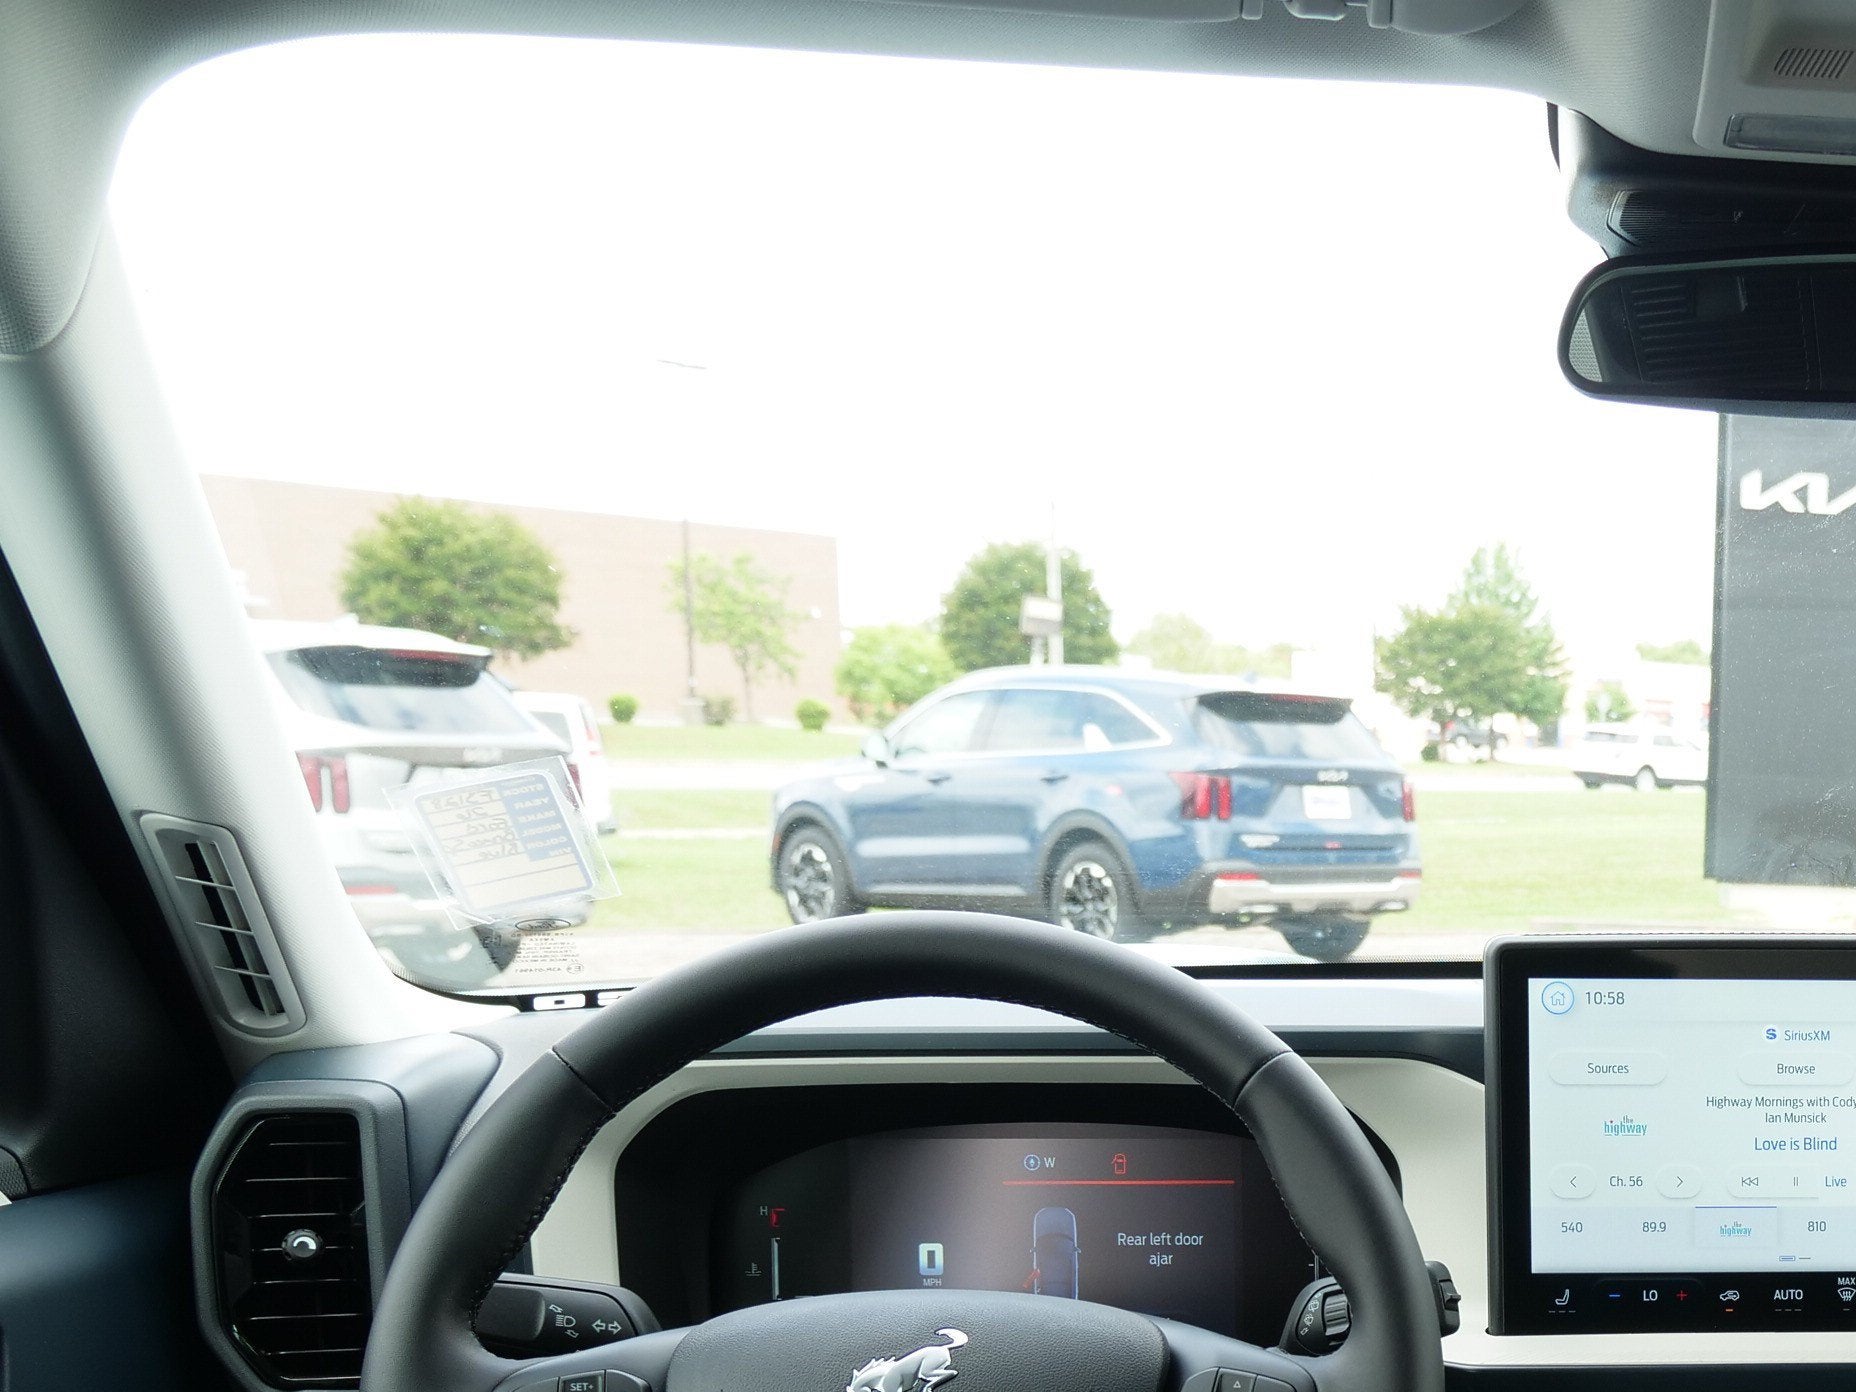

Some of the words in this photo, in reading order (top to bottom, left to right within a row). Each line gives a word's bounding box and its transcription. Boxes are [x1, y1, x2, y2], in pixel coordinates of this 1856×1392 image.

[1585, 991, 1625, 1006] 10:58
[1784, 1030, 1830, 1042] SiriusXM
[1587, 1063, 1629, 1075] Sources
[1777, 1063, 1815, 1075] Browse
[1706, 1096, 1752, 1109] Highway
[1755, 1096, 1804, 1109] Mornings
[1806, 1096, 1830, 1108] with
[1765, 1112, 1781, 1123] Ian
[1784, 1112, 1826, 1124] Munsick
[1604, 1120, 1648, 1136] highway
[1755, 1138, 1786, 1151] Love
[1789, 1138, 1800, 1151] is
[1803, 1137, 1838, 1151] Blind
[1044, 1157, 1056, 1168] W
[1609, 1175, 1625, 1188] Ch.
[1627, 1175, 1643, 1188] 56
[1825, 1176, 1847, 1188] Live
[760, 1206, 768, 1216] H
[1561, 1222, 1583, 1233] 540
[1642, 1222, 1667, 1233] 89.9
[1807, 1221, 1827, 1232] 810
[1117, 1233, 1147, 1246] Rear
[1150, 1232, 1171, 1246] left
[1175, 1232, 1204, 1246] door
[919, 1243, 944, 1276] 0
[1149, 1252, 1173, 1267] ajar
[923, 1279, 942, 1287] MPH
[1837, 1277, 1856, 1286] MAX
[1643, 1290, 1658, 1301] LO
[1774, 1289, 1803, 1301] AUTO
[570, 1383, 594, 1391] SET+
